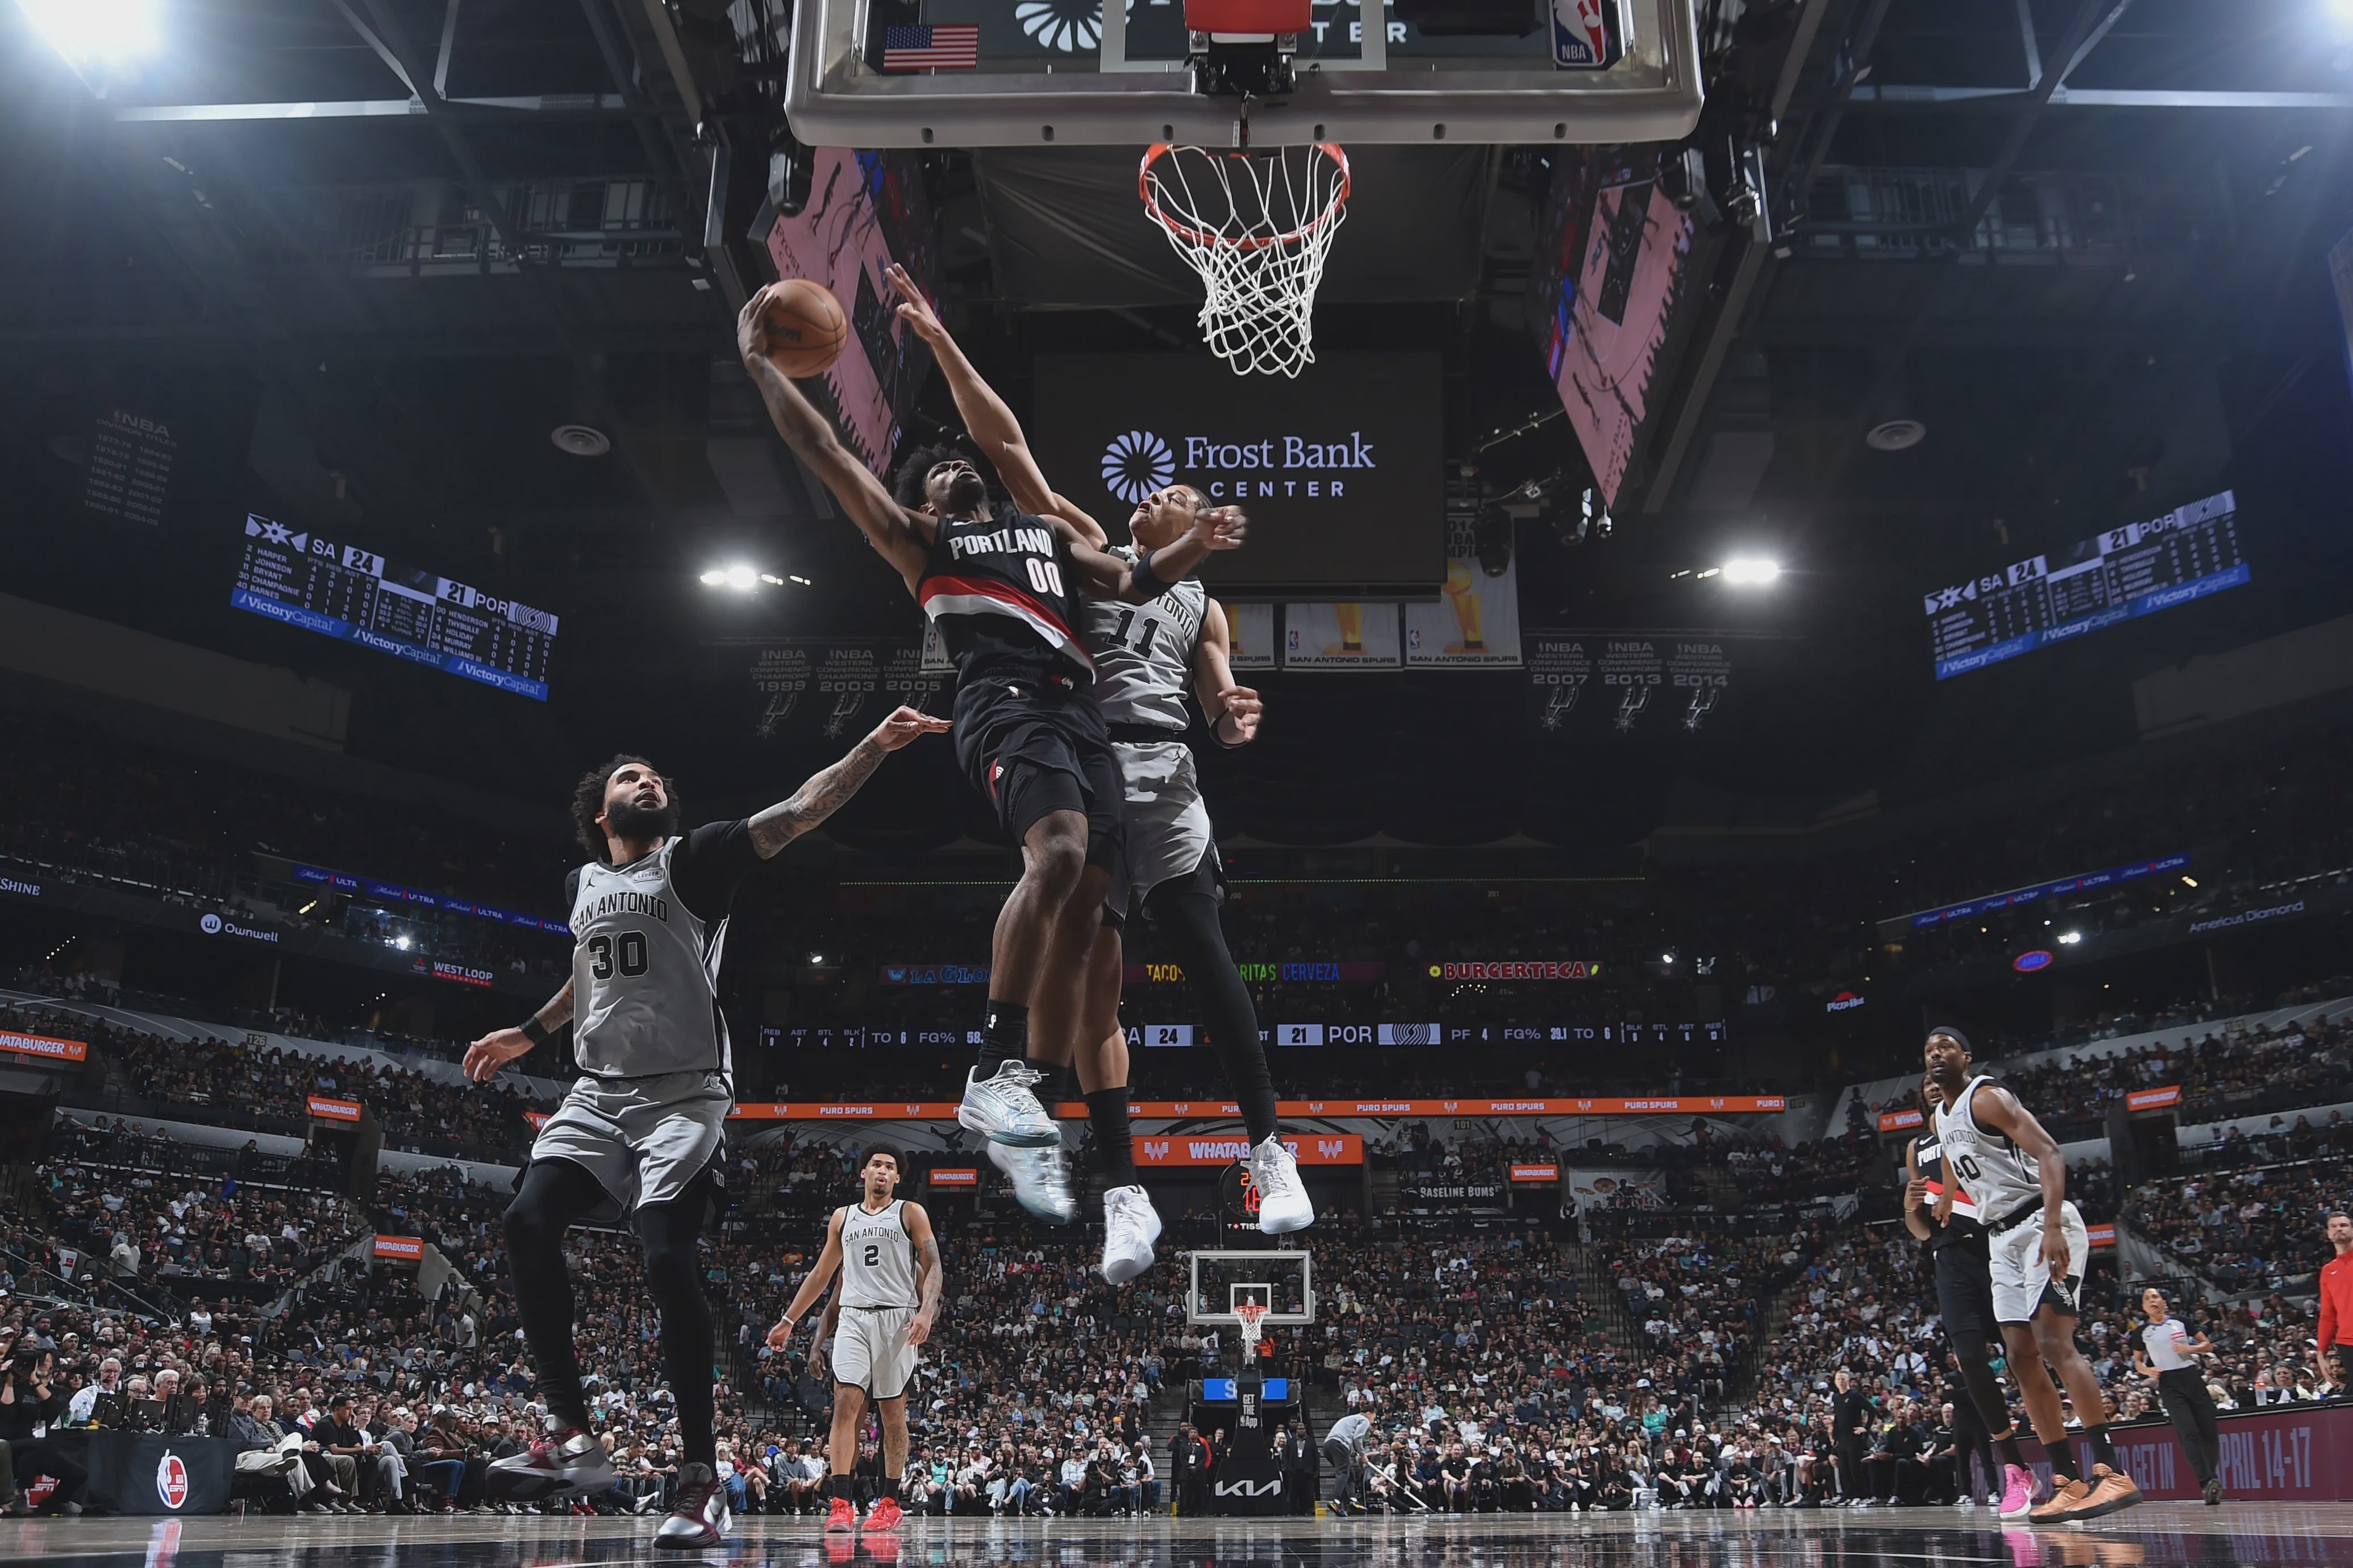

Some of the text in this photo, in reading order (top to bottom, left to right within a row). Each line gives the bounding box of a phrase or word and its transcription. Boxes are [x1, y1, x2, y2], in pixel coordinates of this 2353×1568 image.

[1561, 44, 1586, 60] NBA
[1185, 431, 1376, 469] Frost Bank
[1210, 481, 1344, 497] CENTER
[2110, 513, 2178, 549] 21 POR
[948, 527, 1053, 561] PORTLAND
[257, 547, 288, 563] HARPER
[313, 539, 374, 573] SA 24
[253, 566, 283, 581] BRYANT
[255, 557, 293, 574] JOHNSON
[238, 571, 300, 597] 30 CHAMPAGNIE
[1026, 557, 1065, 598] 00
[1980, 560, 2037, 592] SA 24
[236, 581, 280, 600] 40 BARNES
[447, 583, 508, 615] 21 POR
[248, 596, 335, 632] VictoryCapital
[449, 610, 489, 628] HENDERSON
[1155, 594, 1194, 641] TONIO
[446, 628, 473, 641] HOLIDAY
[448, 619, 480, 635] THYBULLE
[1106, 608, 1161, 662] 11
[361, 631, 442, 665] VictoryCapital
[445, 636, 472, 650] MURRAY
[1546, 643, 1584, 652] NBA
[1615, 642, 1654, 652] NBA
[1684, 644, 1723, 653] NBA
[443, 645, 474, 661] WILLIAMS
[769, 649, 806, 659] NBA
[836, 649, 874, 659] NBA
[465, 663, 540, 695] VictoryCapital
[757, 681, 806, 691] 1999
[820, 681, 875, 691] 2003
[886, 681, 941, 691] 2005
[1532, 674, 1588, 685] 2007
[1605, 674, 1662, 685] 2013
[1673, 675, 1728, 686] 2014
[336, 877, 359, 889] ULTR
[478, 908, 503, 919] ULTRA
[573, 891, 668, 935] SAN ANTONIO
[2189, 900, 2304, 933] Americus Diamond
[224, 923, 278, 943] Ownwell
[544, 922, 568, 933] ULTRA
[588, 930, 649, 982] 30
[434, 961, 464, 975] WEST
[465, 968, 493, 981] LOOP
[910, 966, 991, 983] LA GLO
[1240, 964, 1276, 981] RITAS
[1283, 963, 1340, 981] CERVEZA
[1444, 961, 1586, 980] BURGERTECA
[248, 1035, 266, 1045] 126
[872, 1032, 892, 1044] TO
[901, 1032, 906, 1044] 6
[919, 1032, 956, 1044] FG%
[967, 1032, 984, 1044] 58.
[1159, 1028, 1178, 1045] 24
[1292, 1027, 1306, 1044] 21
[1329, 1025, 1372, 1043] POR
[1451, 1029, 1471, 1040] PF
[1481, 1028, 1488, 1040] 4
[1504, 1029, 1541, 1040] FG%
[1550, 1027, 1567, 1040] 39.1
[1573, 1029, 1594, 1039] TO
[0, 1035, 65, 1054] HATABURGER
[310, 1102, 357, 1115] WHATABURGER
[1455, 1121, 1471, 1129] 101
[1189, 1141, 1299, 1159] WHATABER
[1918, 1143, 1942, 1167] PORT
[1952, 1154, 1981, 1183] 40
[1421, 1186, 1495, 1198] BASELINE BUMS
[844, 1227, 899, 1247] SAN ANTONIO
[375, 1241, 419, 1253] HATABURGER
[864, 1245, 880, 1267] 2
[1243, 1394, 1255, 1404] GET
[1243, 1404, 1255, 1415] THE
[1246, 1415, 1258, 1428] App
[2132, 1443, 2157, 1490] GET
[2159, 1442, 2175, 1490] IN
[2262, 1427, 2311, 1488] 14-17
